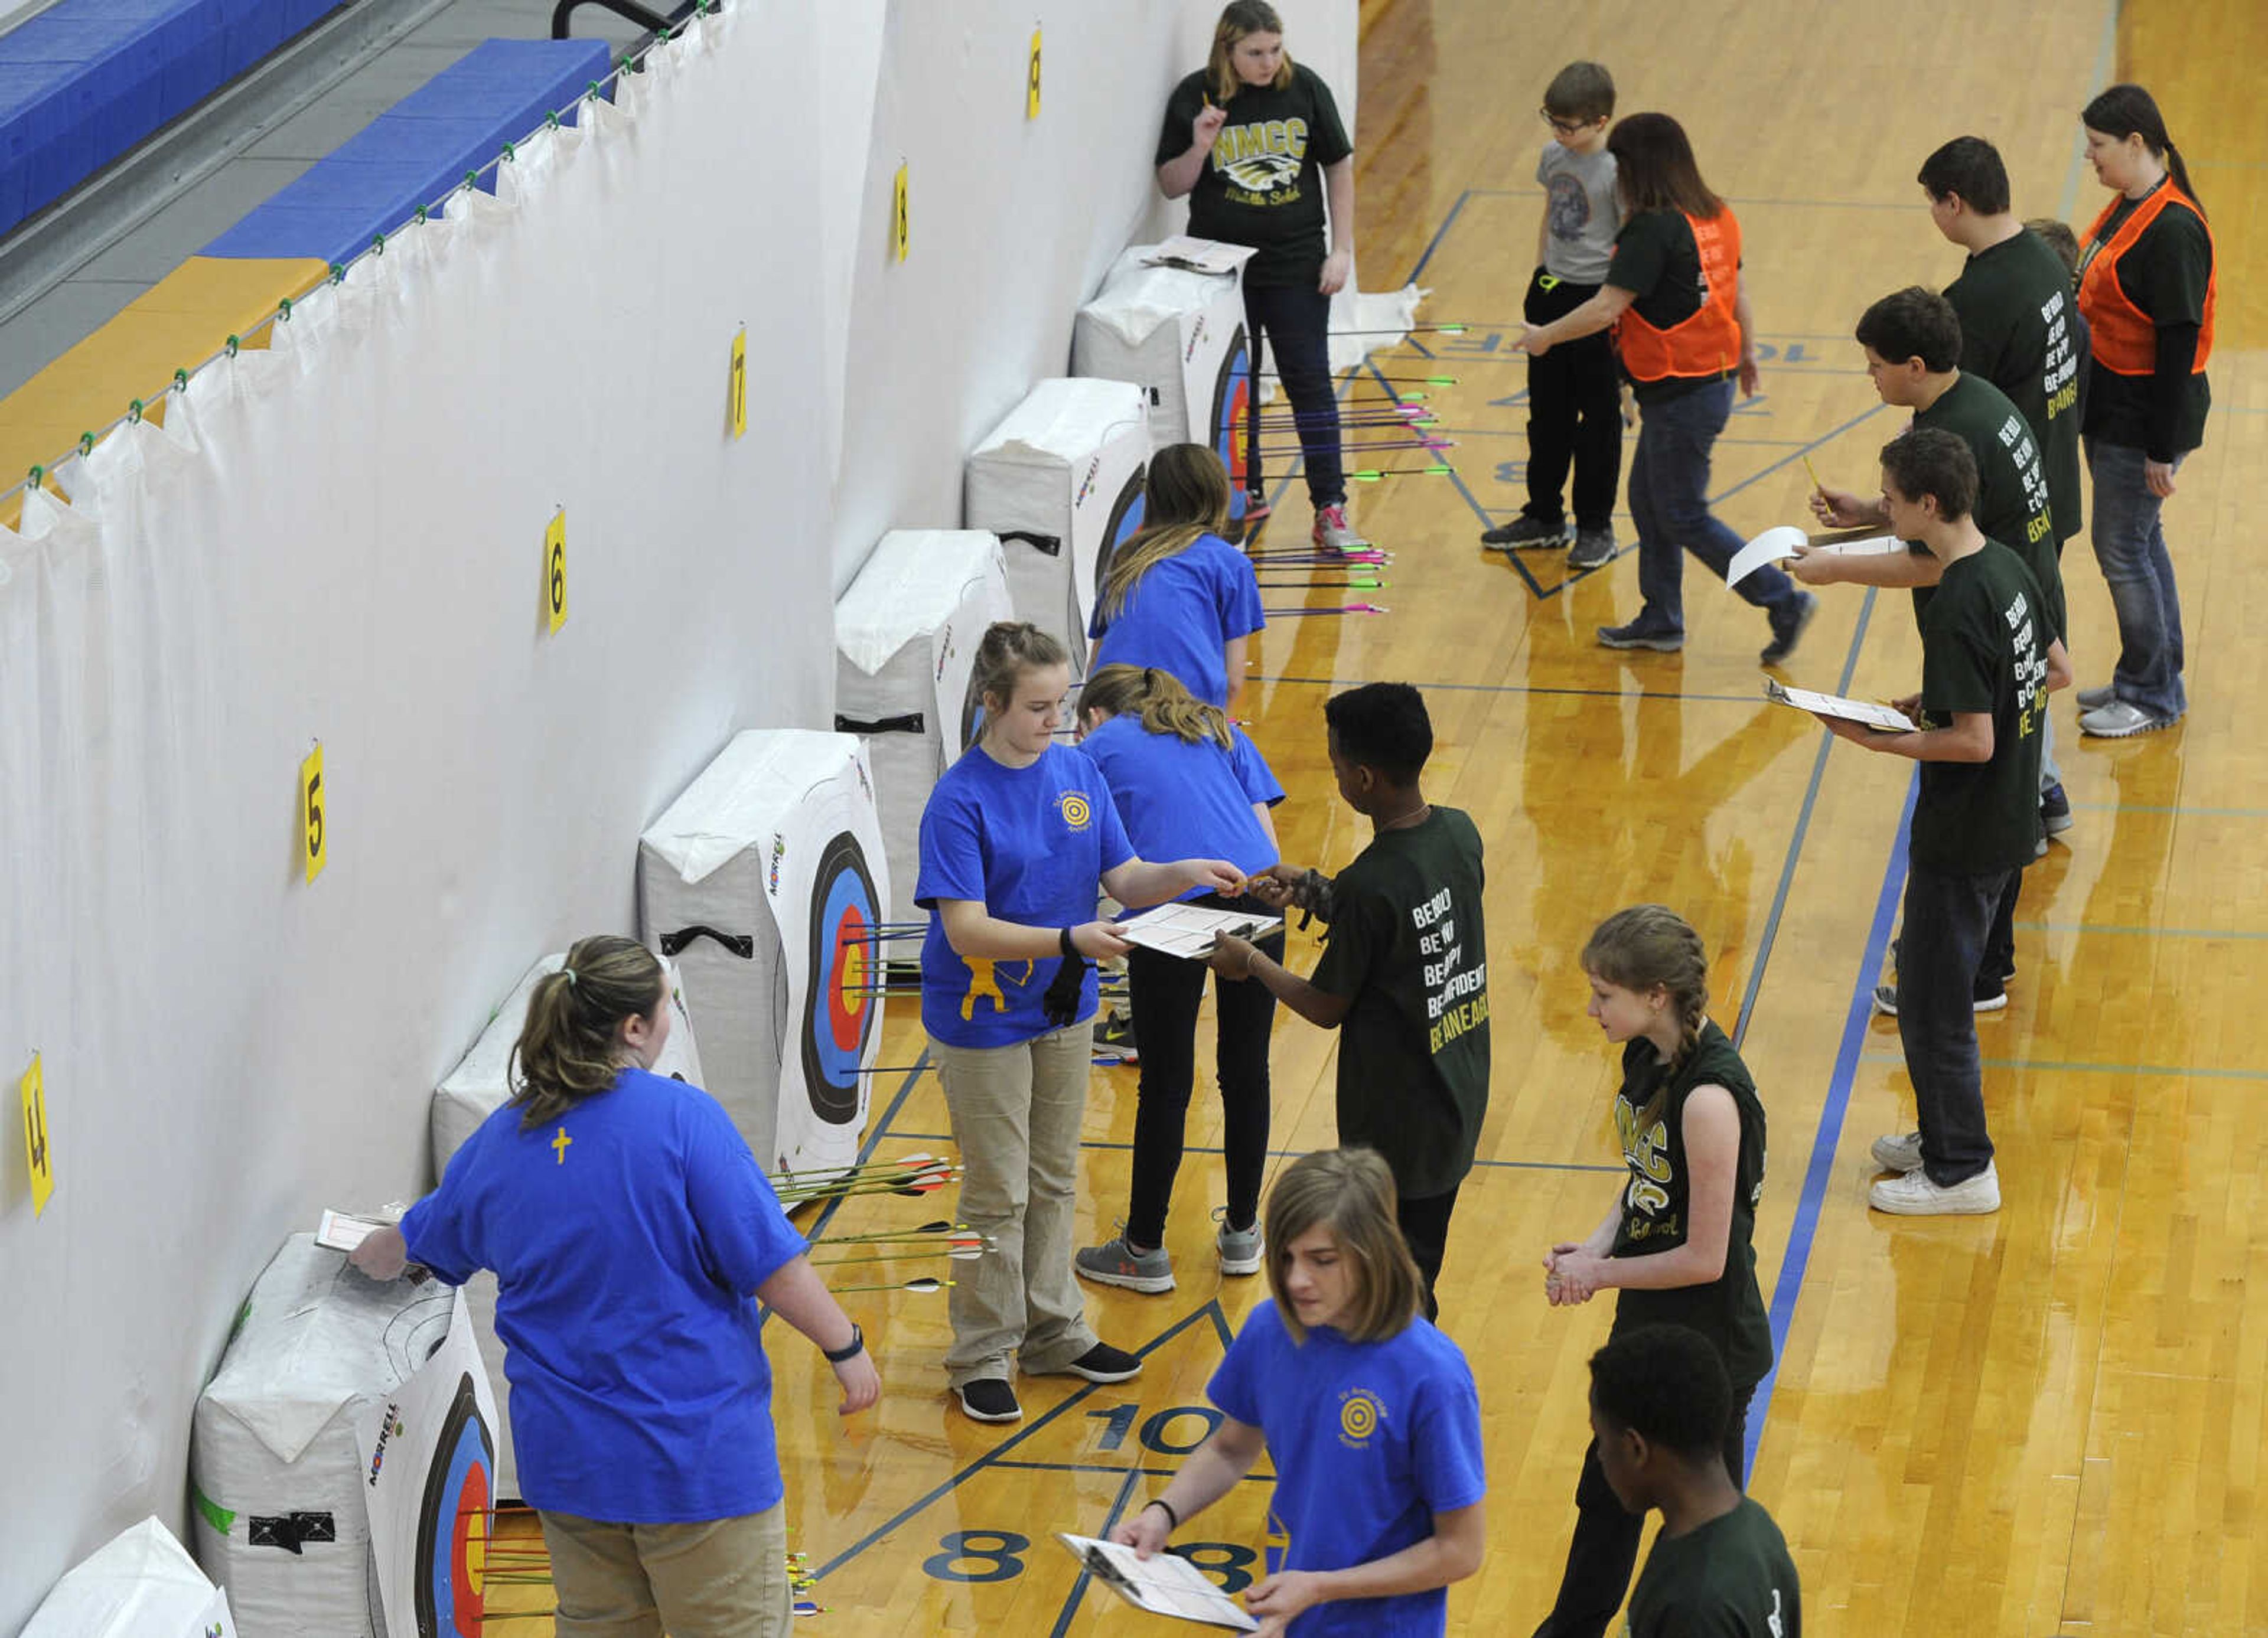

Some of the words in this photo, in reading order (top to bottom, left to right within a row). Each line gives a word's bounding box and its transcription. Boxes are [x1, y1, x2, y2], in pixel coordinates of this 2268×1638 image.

[1030, 49, 1040, 103] 9
[1212, 118, 1309, 172] NMCC
[900, 188, 907, 248] 8
[735, 353, 744, 425] 7
[551, 542, 563, 614] 6
[308, 771, 322, 857] 5
[770, 829, 782, 896] MORRELL
[1412, 902, 1436, 929] BE
[1419, 932, 1443, 955] BE
[1423, 963, 1444, 987] BE
[1427, 994, 1444, 1019] BE
[1442, 1009, 1463, 1044] AN
[28, 1088, 46, 1178] 4
[369, 1402, 398, 1486] MORRELL
[1086, 1404, 1226, 1456] 10
[921, 1530, 1031, 1583] 8
[1169, 1542, 1257, 1594] 8
